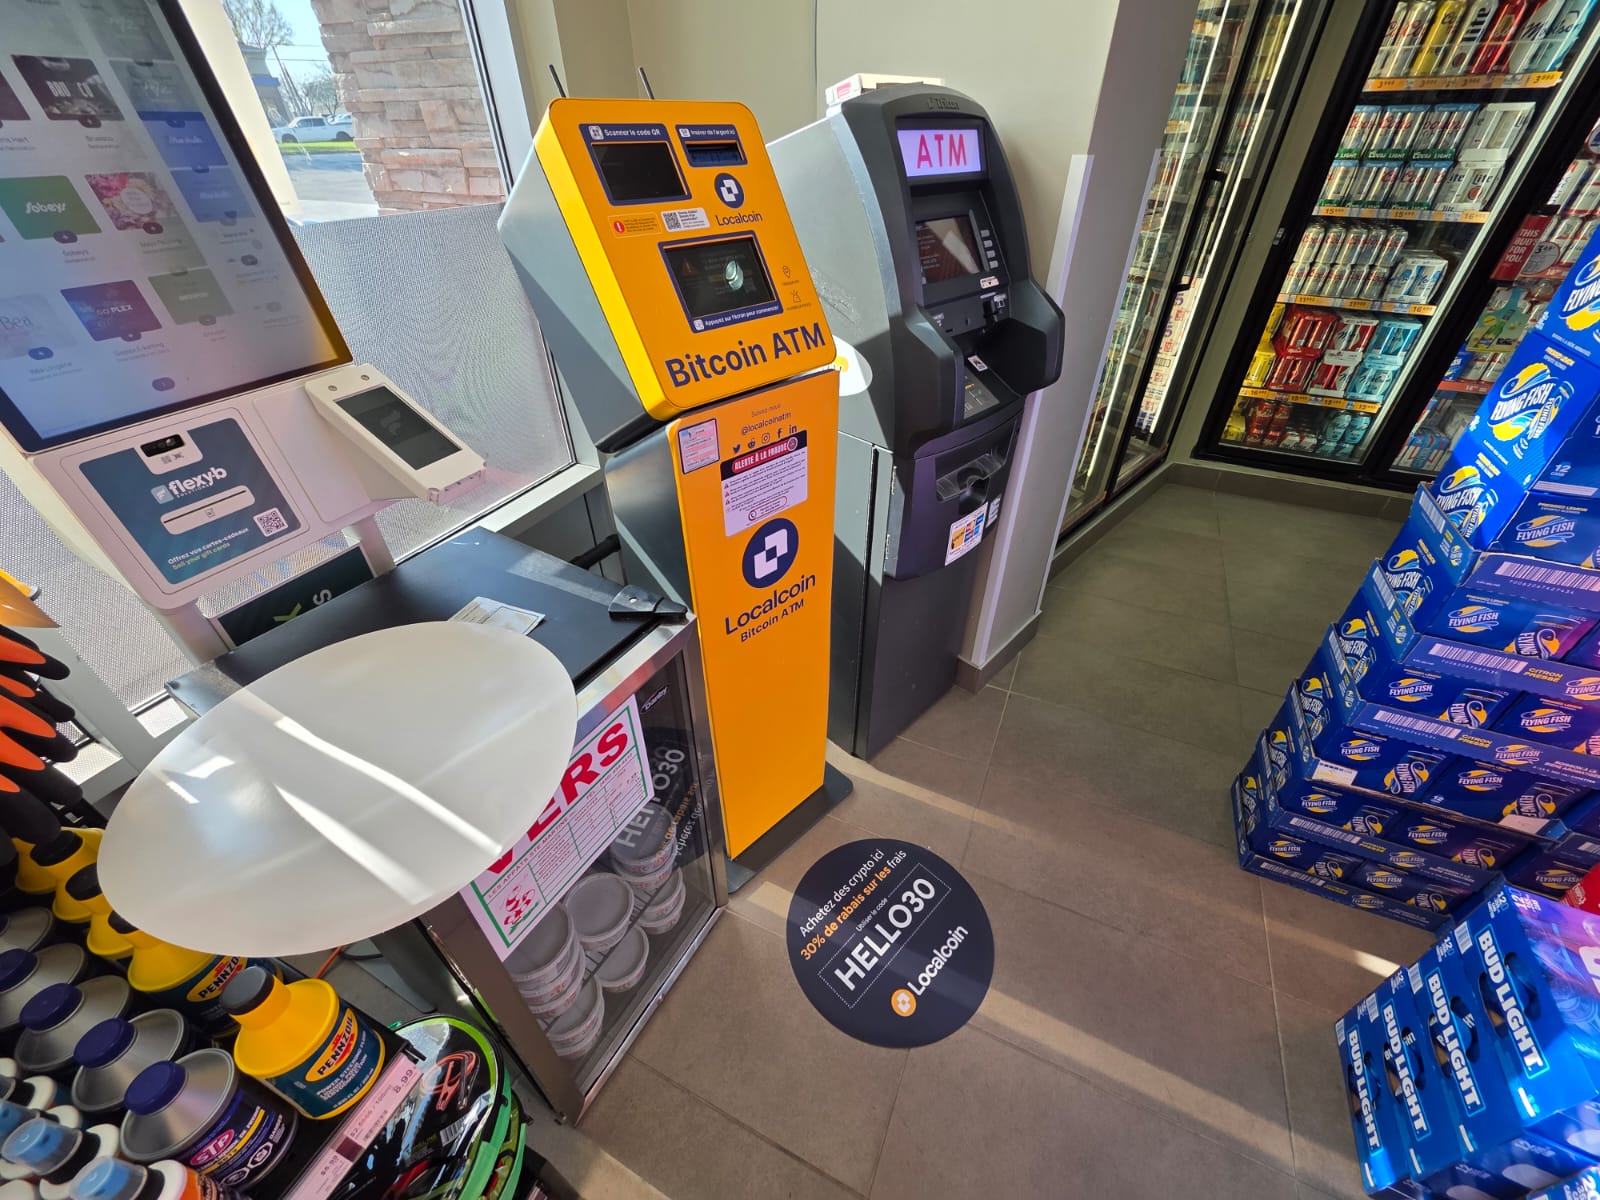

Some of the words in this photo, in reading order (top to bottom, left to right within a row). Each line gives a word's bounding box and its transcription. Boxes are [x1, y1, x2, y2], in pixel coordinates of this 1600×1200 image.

[604, 129, 629, 137] Scanner
[917, 133, 967, 169] ATM
[715, 210, 763, 227] Localcoin
[1519, 229, 1540, 237] THIS
[1509, 246, 1527, 254] FOR
[665, 340, 767, 388] Bitcoin
[772, 322, 826, 360] ATM
[1490, 393, 1526, 421] FLYING
[1523, 382, 1557, 409] FISH
[741, 411, 792, 436] @localcoinatm
[1516, 526, 1550, 541] FLYING
[1550, 521, 1575, 535] FISH
[725, 574, 816, 635] Localcoin
[740, 614, 779, 642] Bitcoin
[781, 598, 804, 618] ATM
[1448, 615, 1478, 627] FLYING
[1478, 612, 1499, 622] FISH
[1389, 686, 1415, 696] FLYING
[1414, 684, 1433, 693] FISH
[1565, 685, 1596, 694] FLYING
[1520, 718, 1550, 726] FLYING
[1550, 715, 1572, 724] FISH
[1341, 747, 1363, 755] FLYING
[1363, 745, 1380, 753] FISH
[1495, 751, 1521, 759] FLYING
[487, 722, 628, 874] ERS
[799, 899, 836, 938] Achetez
[833, 885, 851, 903] des
[848, 861, 876, 889] crypto
[872, 849, 885, 863] ici
[800, 934, 826, 961] 30%
[824, 920, 839, 937] de
[836, 892, 866, 925] rabais
[863, 879, 879, 897] sur
[874, 866, 891, 883] les
[887, 849, 907, 870] frais
[876, 897, 889, 911] code
[834, 878, 936, 992] HELLO30
[198, 956, 239, 999] PENNZO
[907, 924, 969, 996] Localcoin
[1478, 930, 1505, 984] BUD
[1495, 982, 1544, 1069] LIGHT
[317, 1016, 353, 1076] PENNZOIL
[1428, 973, 1451, 1026] BUD
[1442, 1024, 1481, 1106] LIGHT
[1383, 1004, 1402, 1054] BUD
[1394, 1054, 1428, 1132] LIGHT
[1348, 1029, 1364, 1076] BUD
[1356, 1075, 1381, 1148] LIGHT
[195, 1133, 230, 1162] STP
